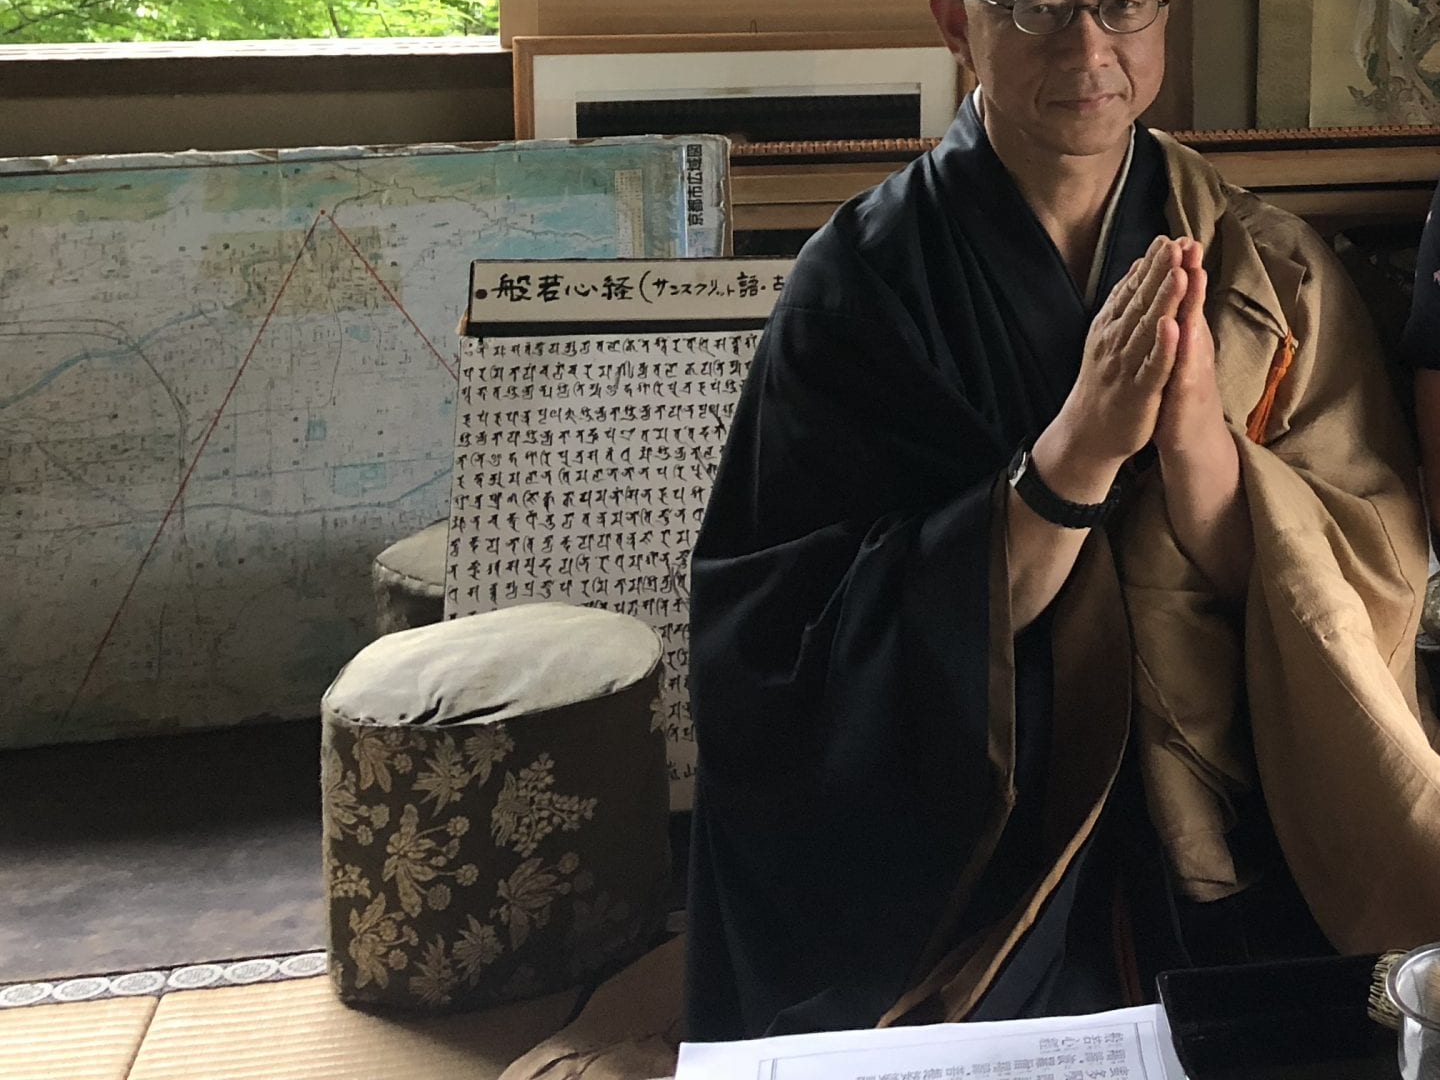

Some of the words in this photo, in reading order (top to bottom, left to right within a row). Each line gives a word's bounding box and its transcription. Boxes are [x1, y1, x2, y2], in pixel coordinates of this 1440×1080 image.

[686, 144, 704, 226] 京都市広域図
